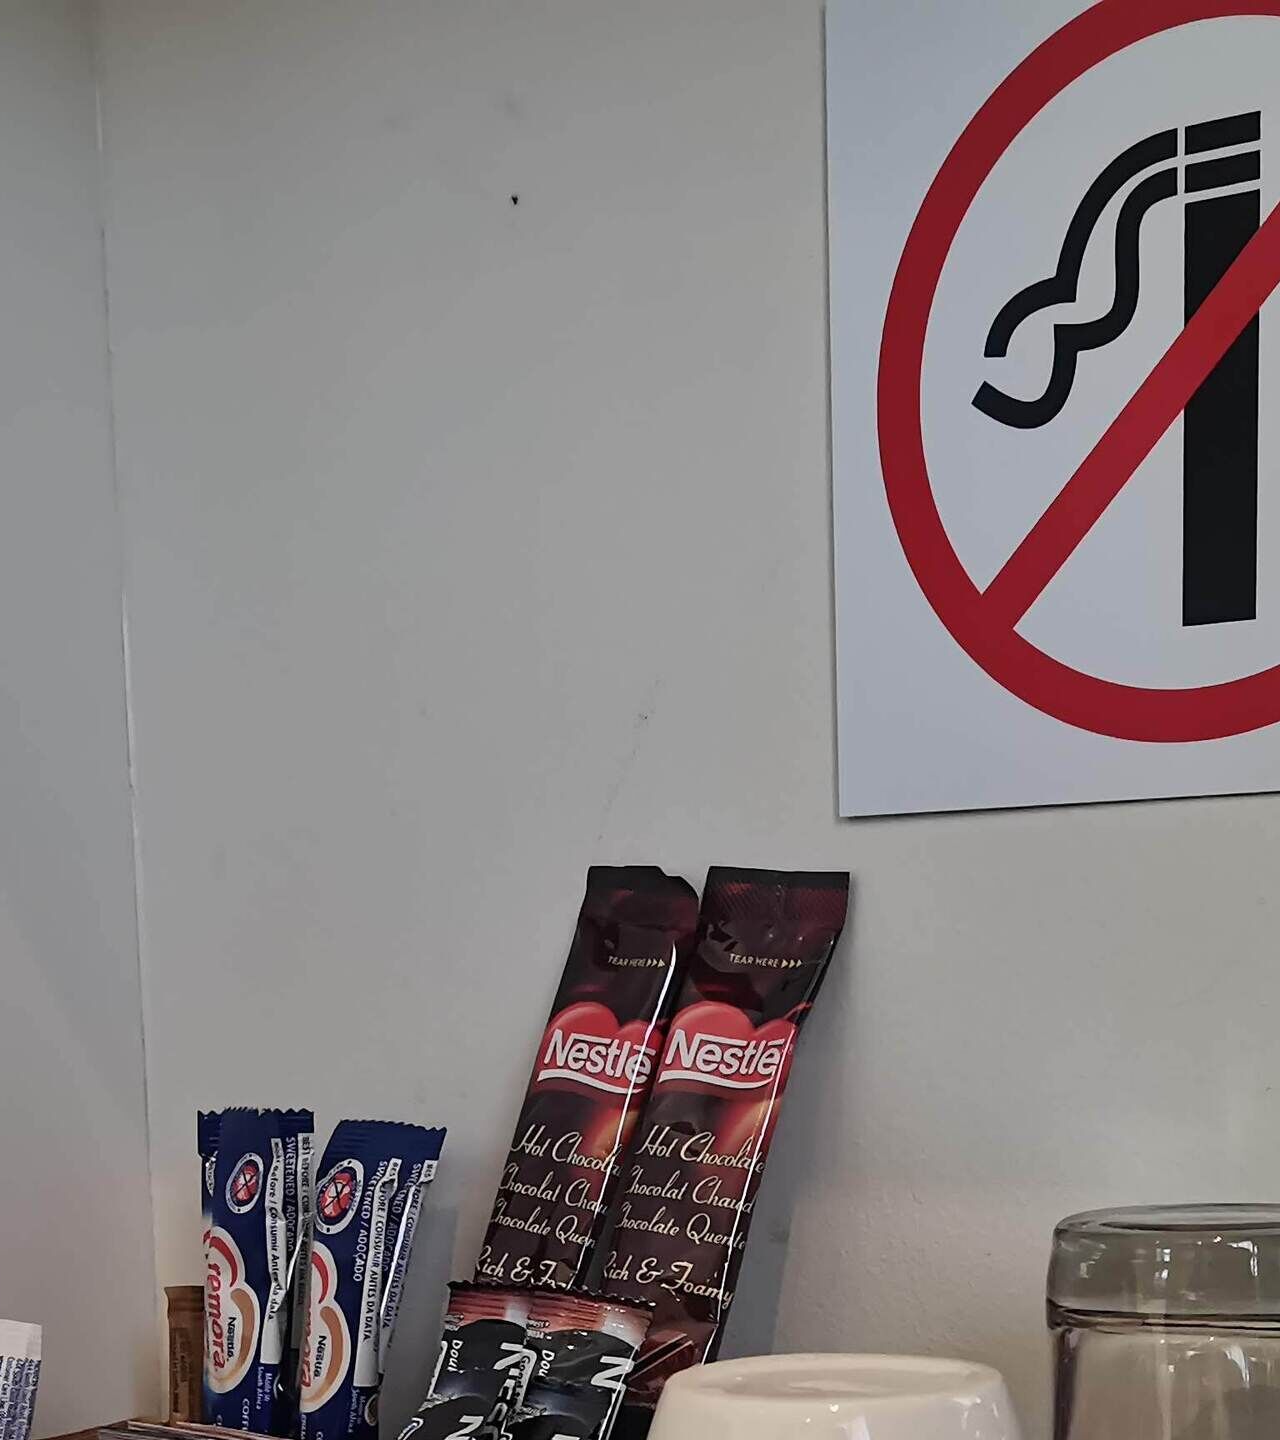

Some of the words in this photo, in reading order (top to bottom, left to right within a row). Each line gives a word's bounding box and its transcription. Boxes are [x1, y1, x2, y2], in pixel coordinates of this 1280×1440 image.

[729, 953, 753, 965] TEAR
[756, 956, 780, 969] HERE
[665, 1028, 786, 1077] Nestlé
[511, 1124, 551, 1158] Hot
[635, 1125, 678, 1158] Hot
[680, 1132, 765, 1174] Chocolate
[285, 1136, 297, 1196] SWEETENED
[389, 1162, 399, 1177] BES
[353, 1229, 369, 1282] ADOÇADO
[510, 1256, 534, 1283] &
[367, 1271, 378, 1297] ANTES
[635, 1257, 664, 1284] &
[660, 1261, 736, 1310] Foamy
[365, 1301, 376, 1314] DA
[363, 1316, 373, 1342] DATA
